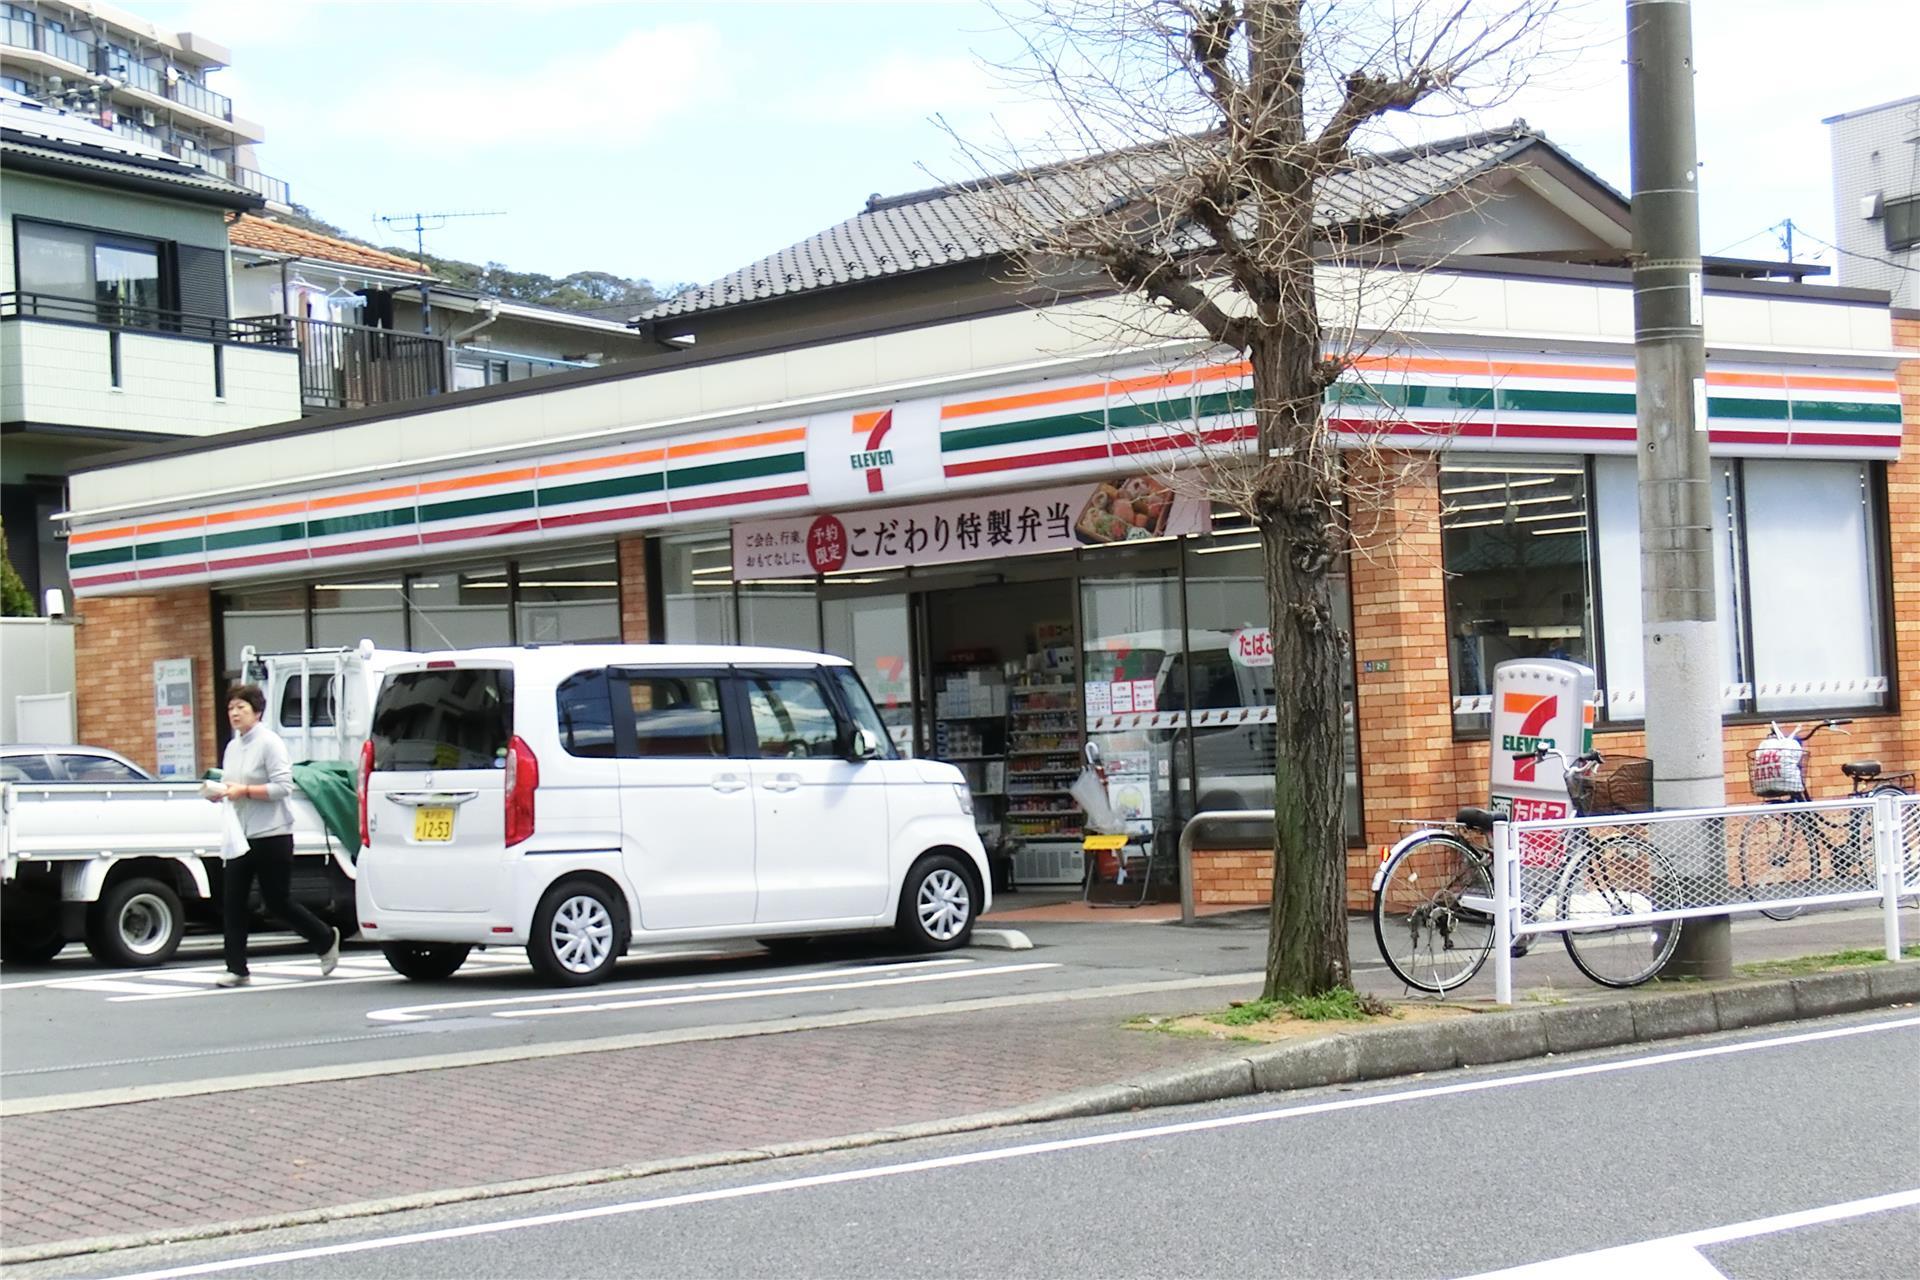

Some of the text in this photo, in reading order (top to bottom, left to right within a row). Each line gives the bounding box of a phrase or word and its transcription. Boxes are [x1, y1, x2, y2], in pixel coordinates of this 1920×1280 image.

[852, 408, 892, 493] 7
[813, 523, 838, 546] 予約
[815, 543, 842, 566] 限定
[850, 502, 1070, 557] こだわり特製弁当
[1503, 692, 1558, 783] 7
